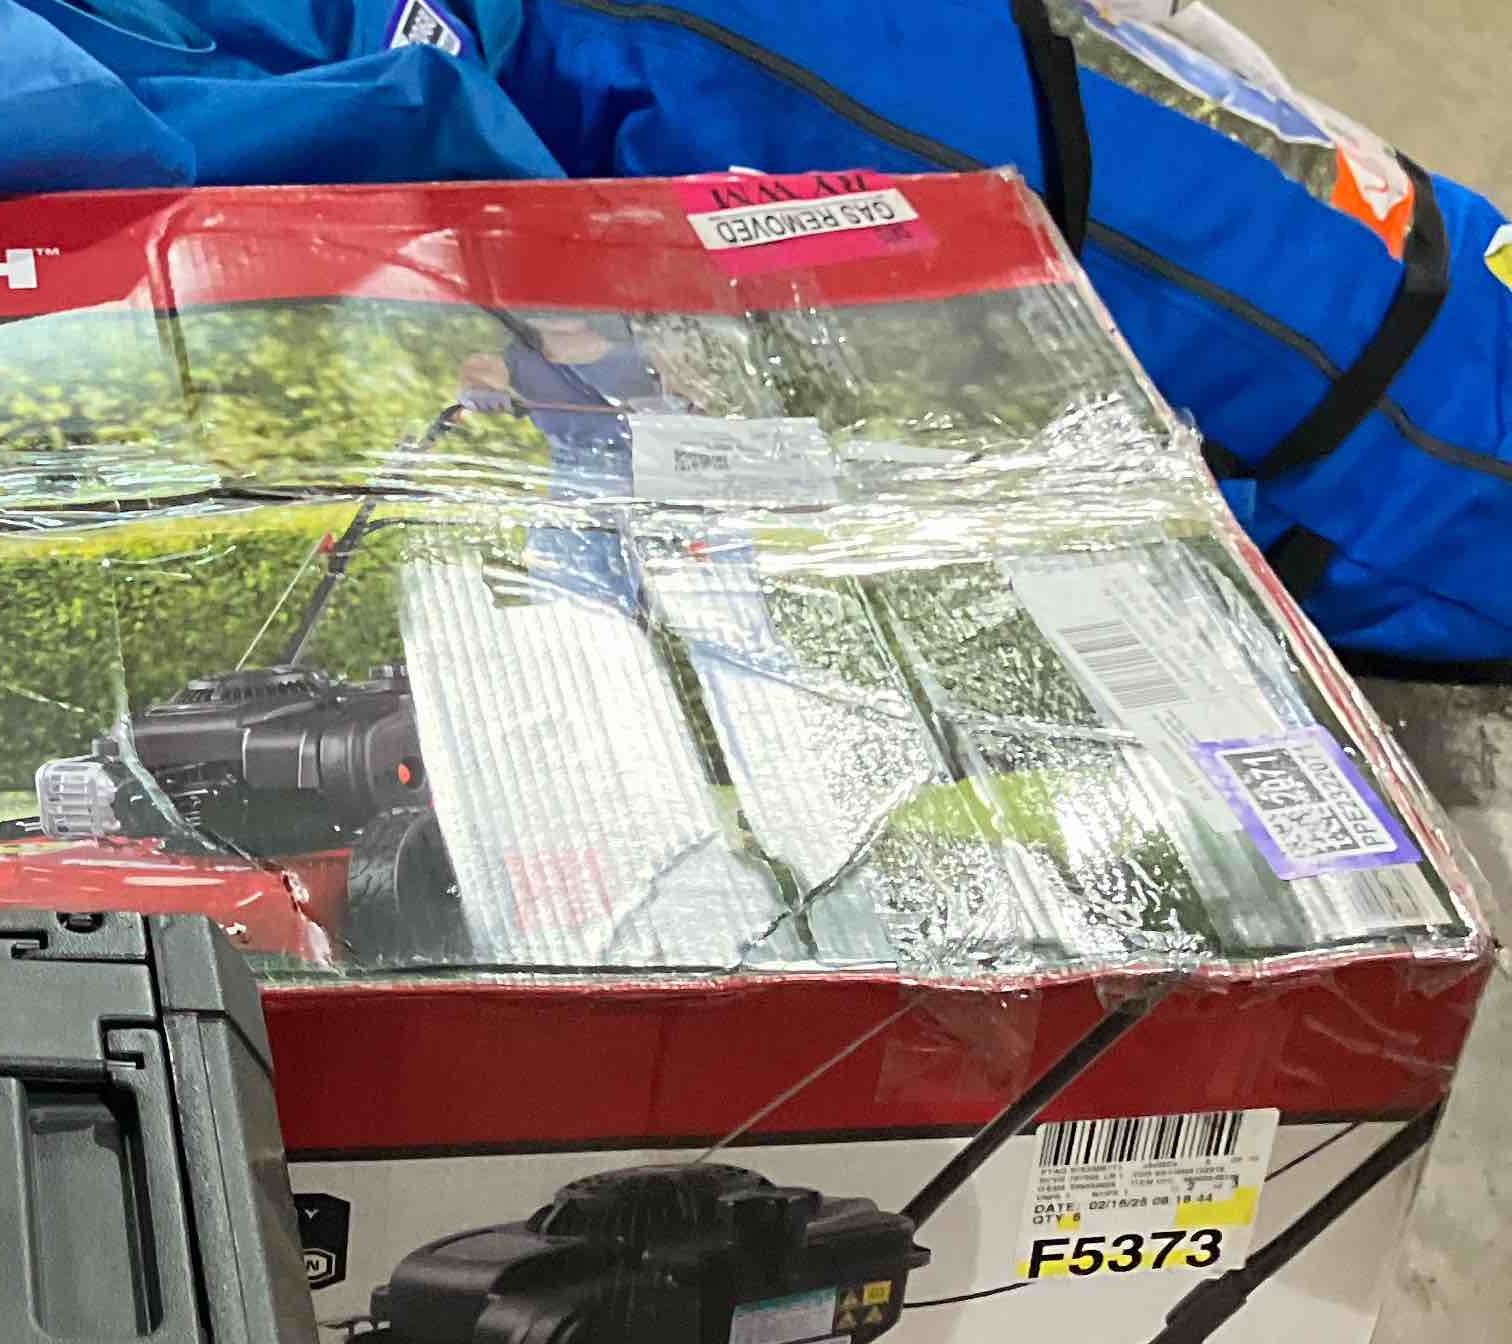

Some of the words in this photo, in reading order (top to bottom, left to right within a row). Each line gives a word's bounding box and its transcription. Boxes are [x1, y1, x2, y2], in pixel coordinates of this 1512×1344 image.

[716, 208, 839, 243] REMOVED
[840, 200, 896, 225] GAS
[1241, 756, 1289, 805] 2071
[1028, 1228, 1223, 1279] F5373
